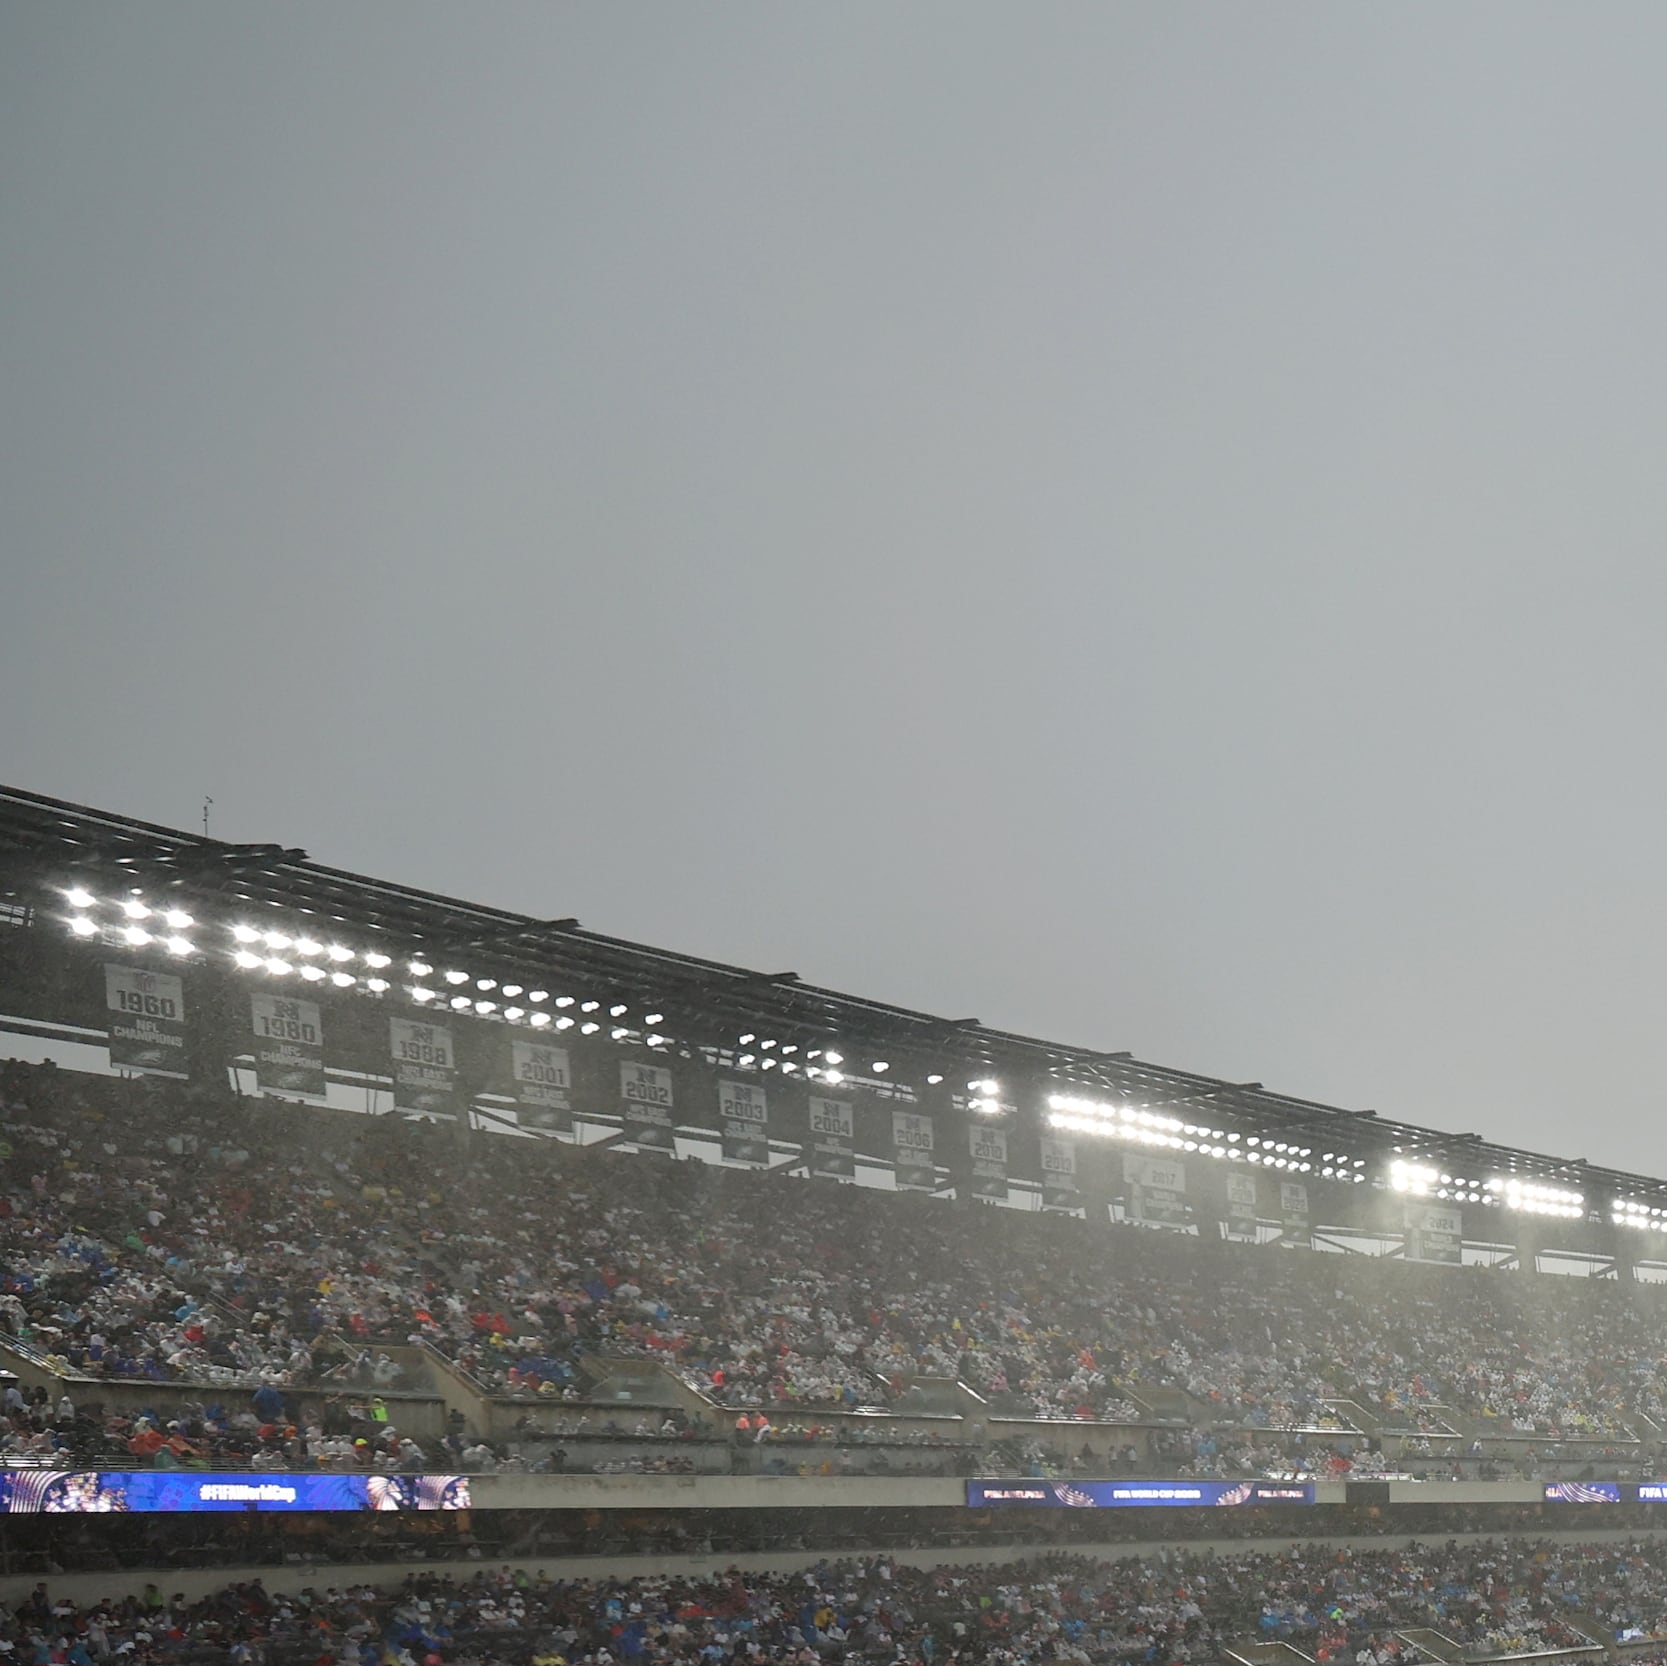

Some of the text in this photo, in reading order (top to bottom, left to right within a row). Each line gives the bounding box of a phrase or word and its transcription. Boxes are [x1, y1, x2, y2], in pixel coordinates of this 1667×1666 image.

[116, 990, 176, 1018] 1960
[114, 1025, 183, 1047] CHAMPIONS
[261, 1016, 316, 1040] 1980
[522, 1062, 564, 1084] 2001
[626, 1081, 668, 1103] 2002
[724, 1100, 762, 1121] 2003
[814, 1114, 850, 1135] 2004
[1640, 1487, 1661, 1498] FIFA
